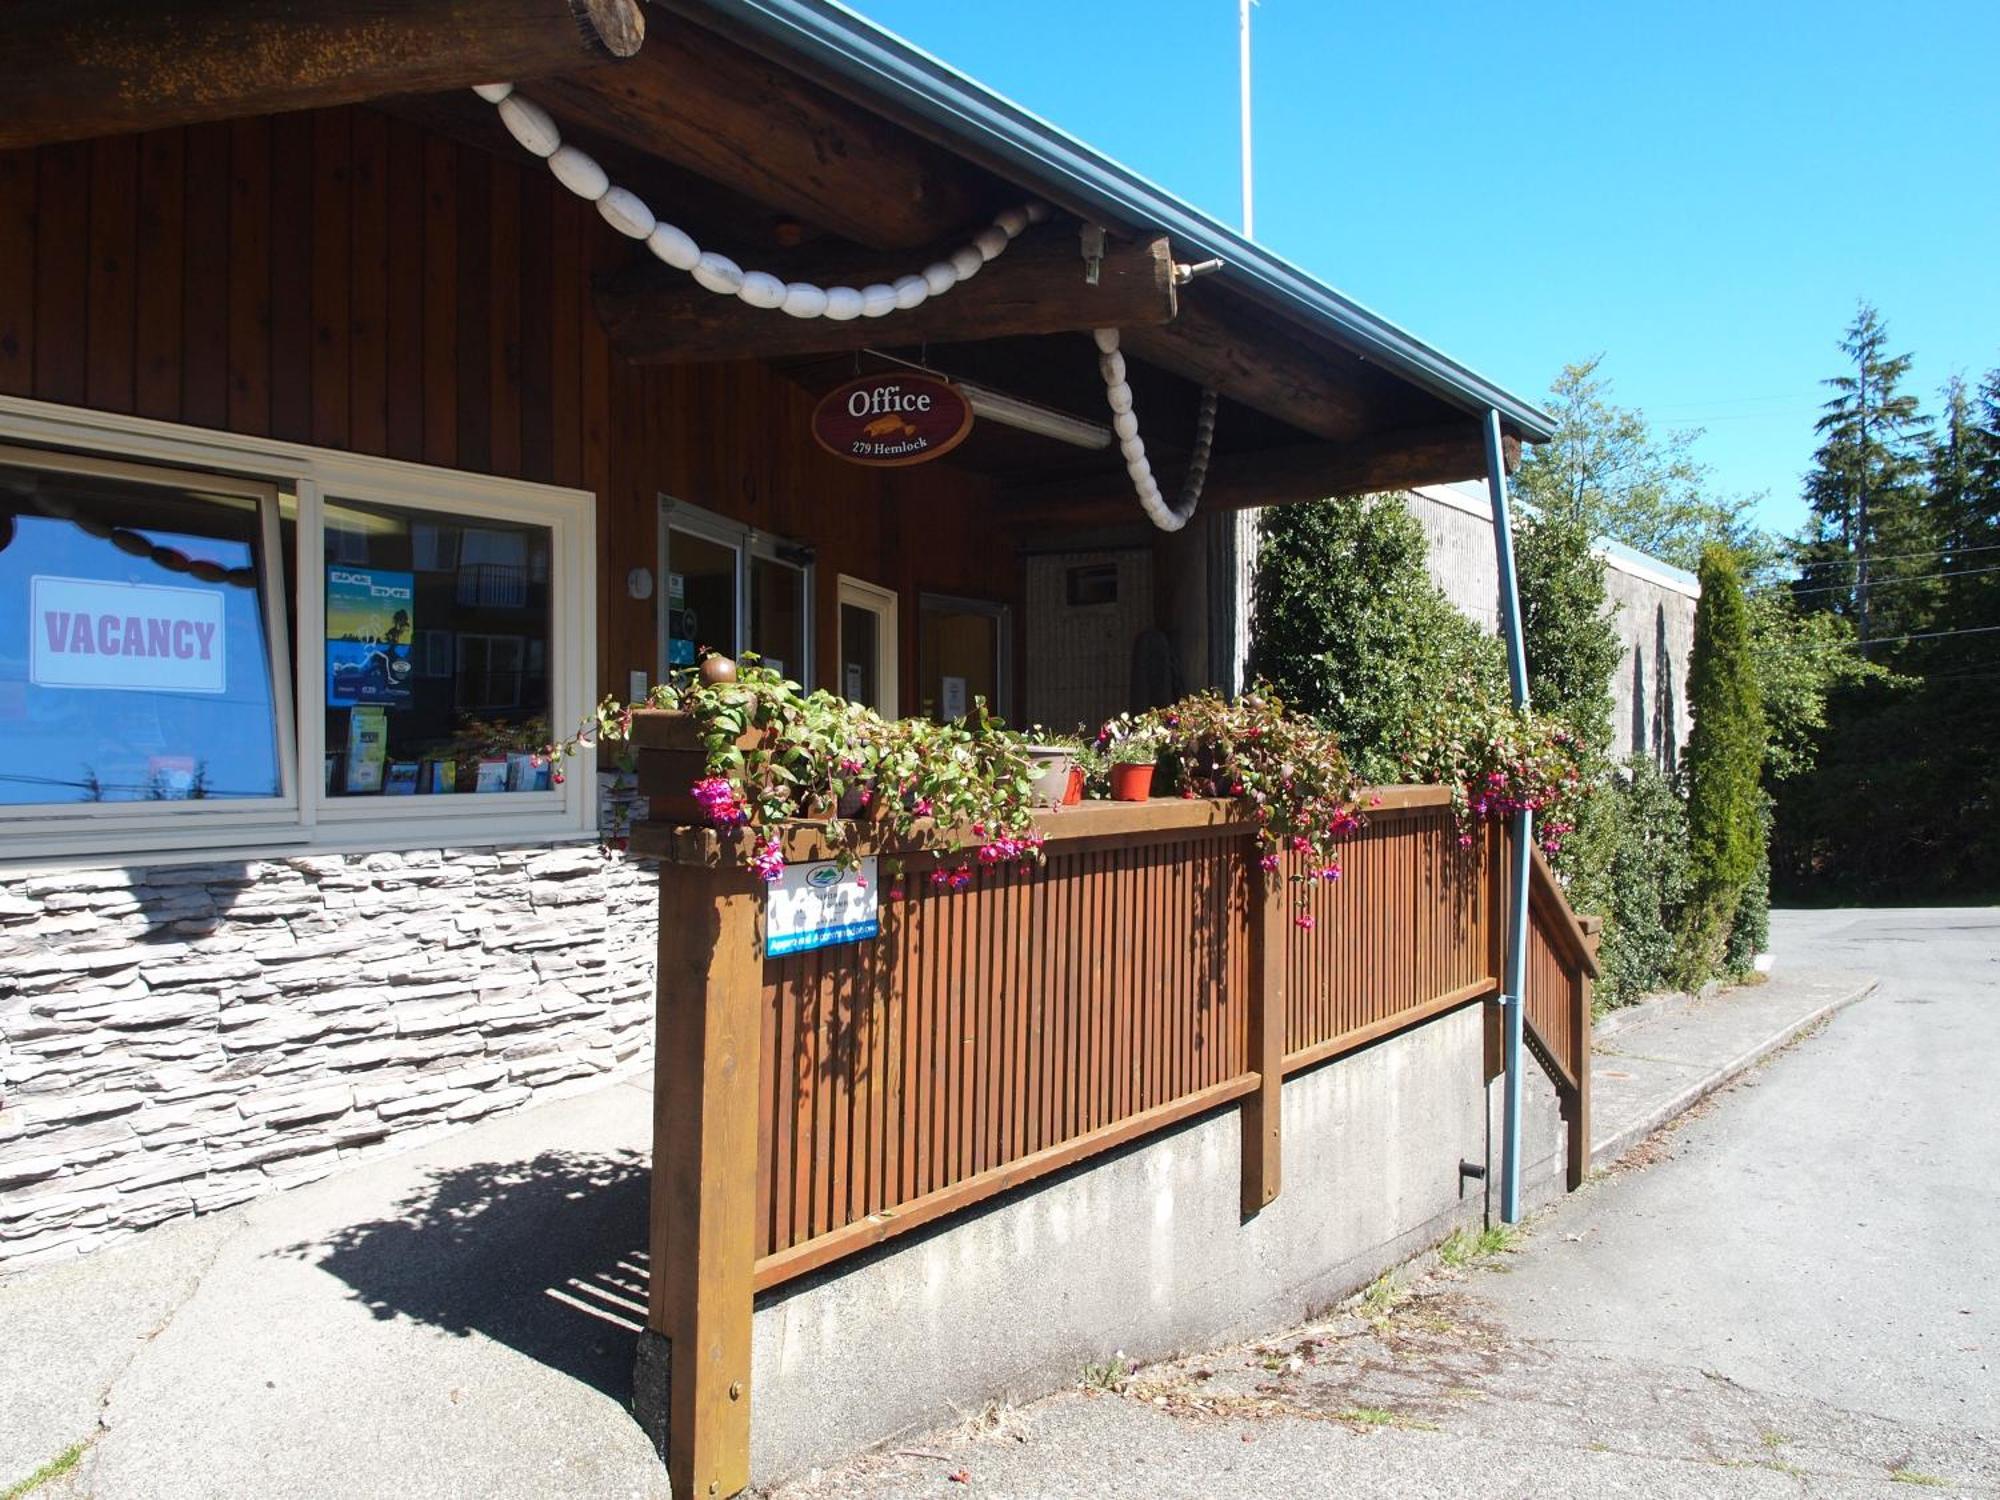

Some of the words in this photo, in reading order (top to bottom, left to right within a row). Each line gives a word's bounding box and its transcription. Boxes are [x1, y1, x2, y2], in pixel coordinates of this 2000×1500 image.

[848, 386, 931, 416] Office
[852, 441, 872, 454] 279
[874, 437, 928, 454] Hemlock
[371, 586, 410, 599] EDGE
[44, 611, 216, 660] VACANCY
